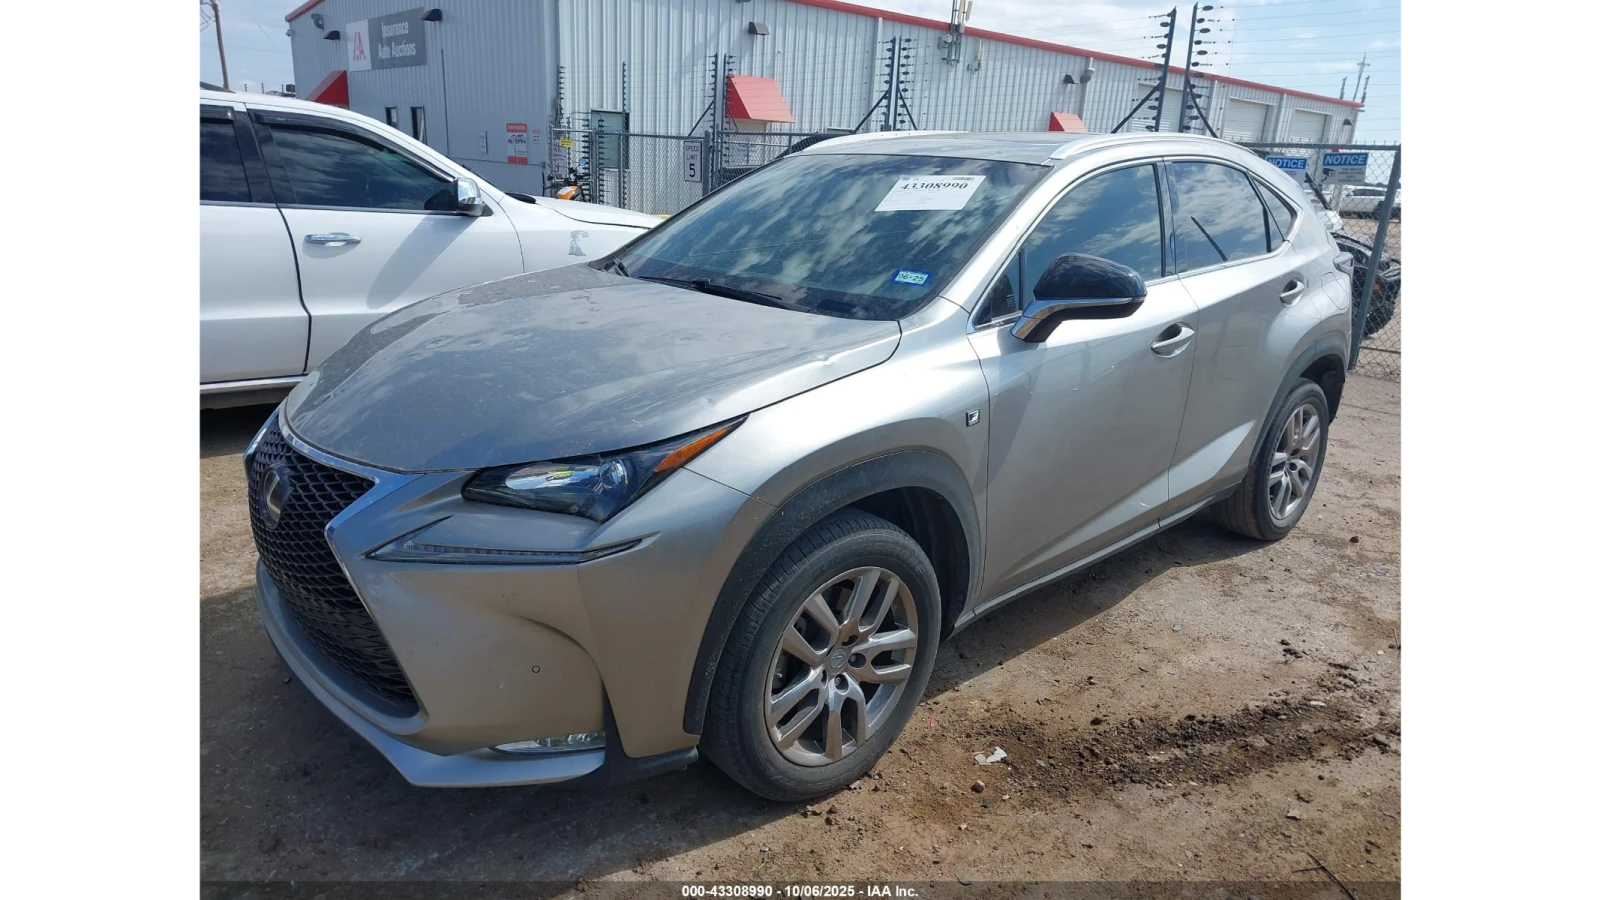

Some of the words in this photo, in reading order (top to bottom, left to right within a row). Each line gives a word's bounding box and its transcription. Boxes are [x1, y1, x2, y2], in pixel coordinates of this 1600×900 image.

[381, 21, 409, 38] Insurance
[378, 43, 391, 60] Auto
[391, 40, 417, 58] Auctions
[685, 144, 699, 152] SPEED
[1268, 158, 1305, 169] NOTICE
[1324, 154, 1366, 165] NOTICE
[688, 163, 696, 178] 5
[900, 182, 969, 190] 43308990
